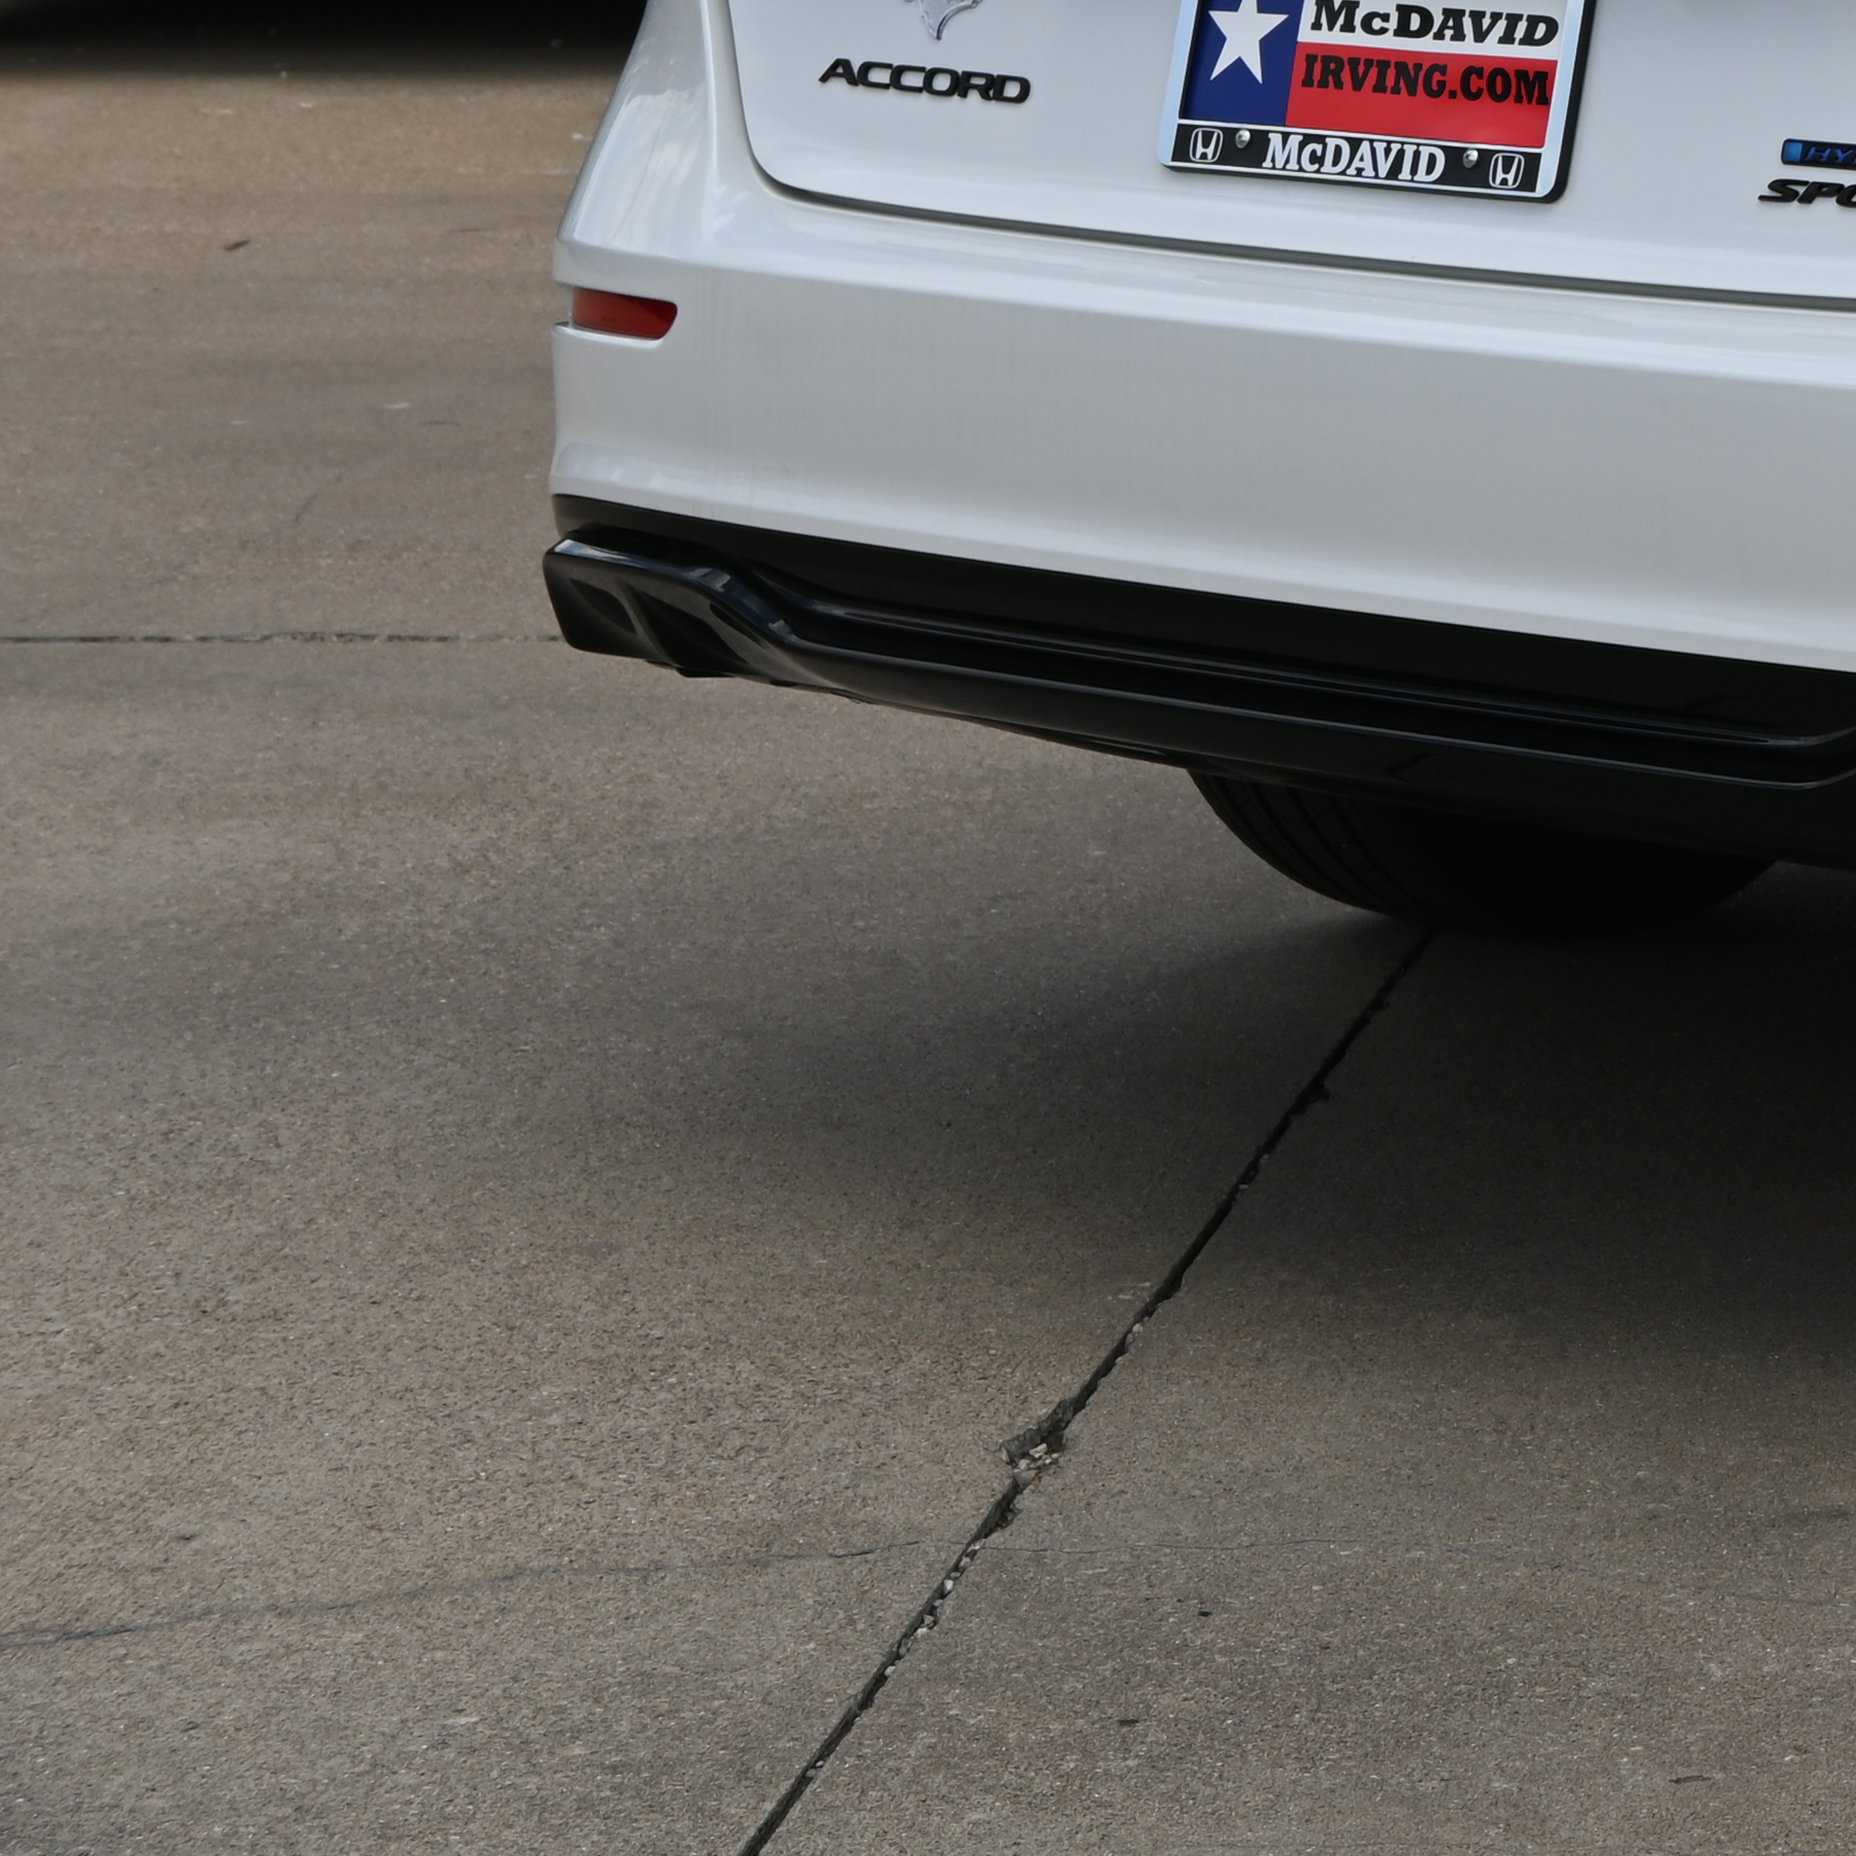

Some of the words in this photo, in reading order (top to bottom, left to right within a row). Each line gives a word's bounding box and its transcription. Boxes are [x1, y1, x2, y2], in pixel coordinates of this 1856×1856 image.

[818, 57, 1032, 105] ACCORD
[1301, 54, 1550, 106] IRVING.COM
[1262, 132, 1446, 183] McDAVID
